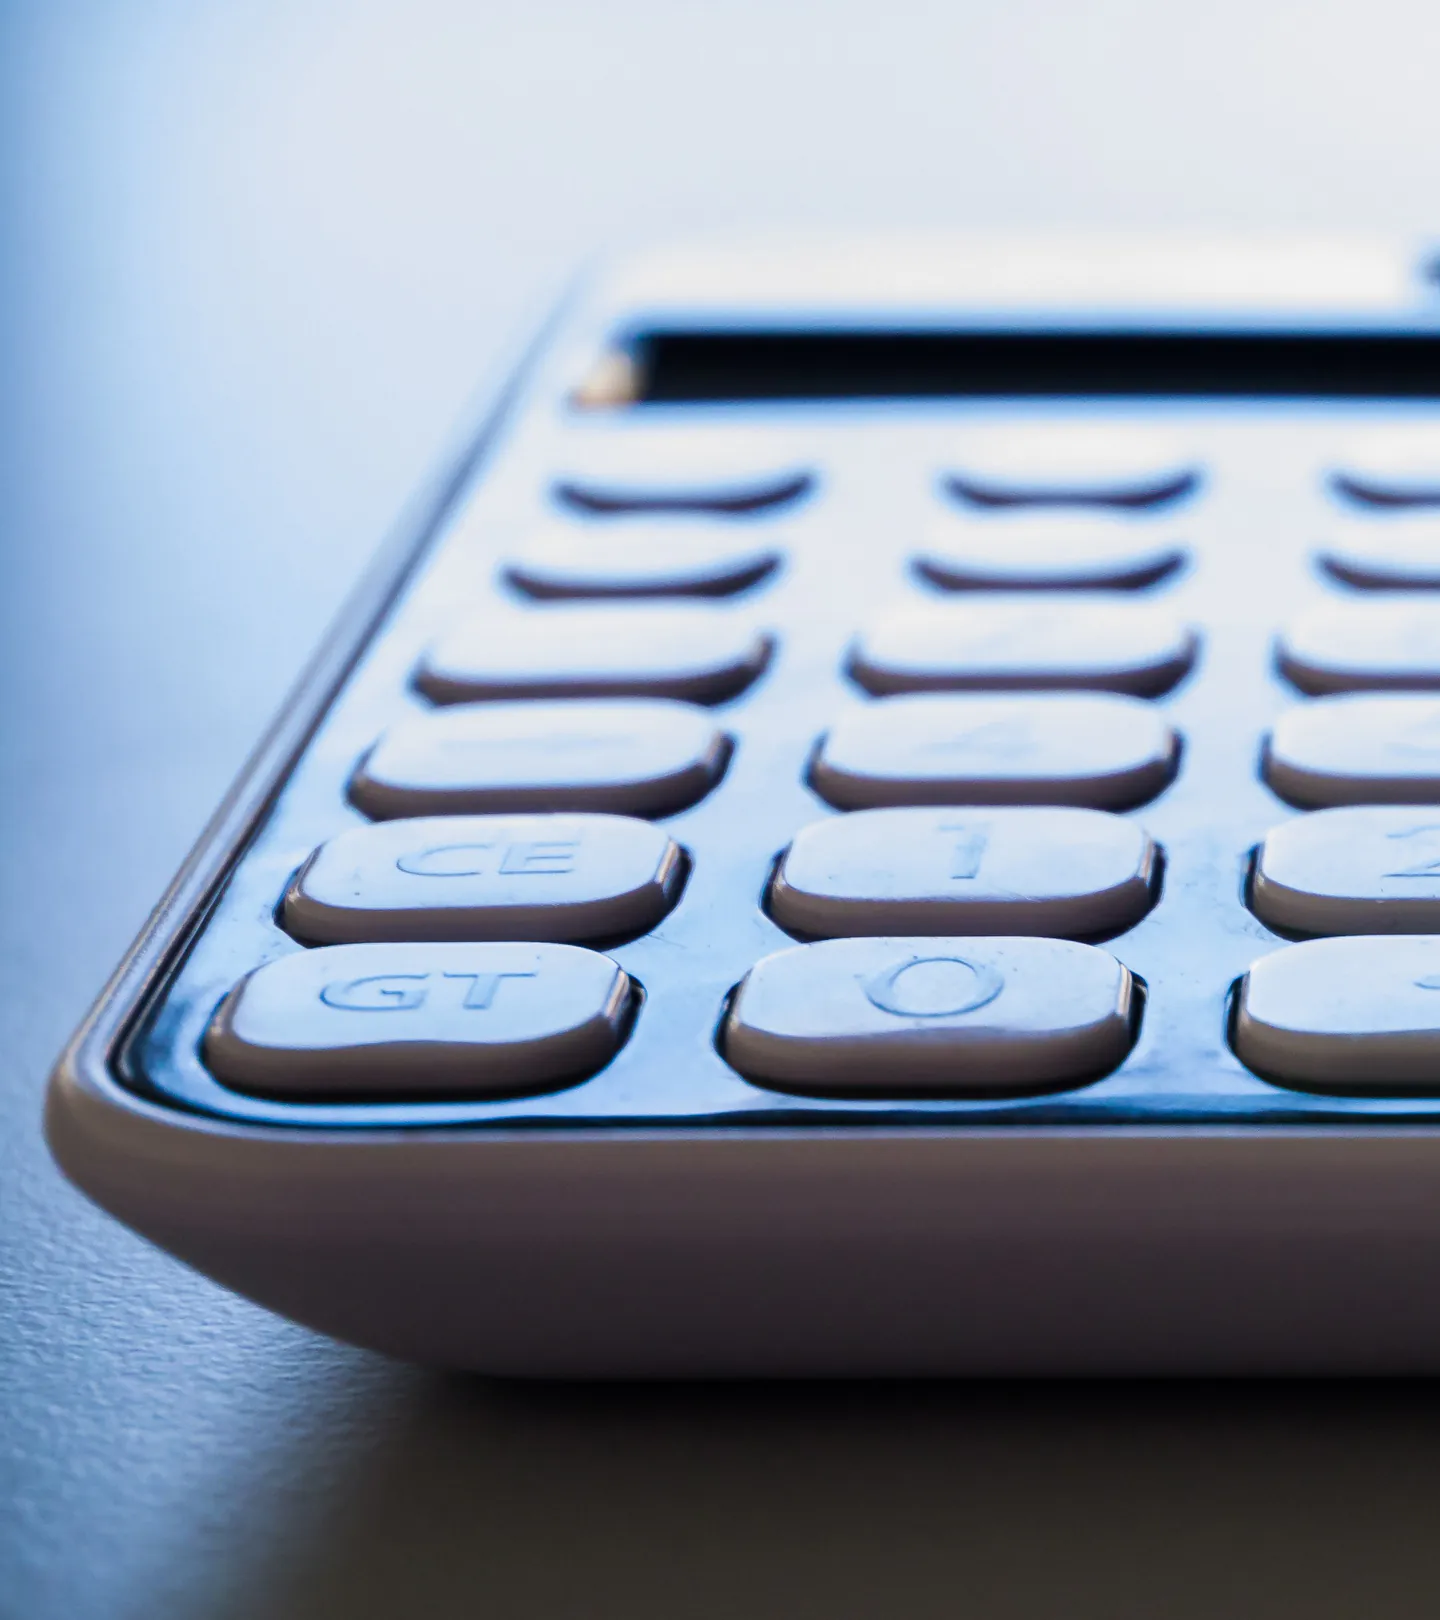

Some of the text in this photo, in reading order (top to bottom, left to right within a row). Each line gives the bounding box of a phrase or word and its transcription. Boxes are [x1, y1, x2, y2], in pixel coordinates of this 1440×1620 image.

[396, 841, 579, 876] CE
[937, 822, 991, 880] 1
[319, 970, 538, 1012] GT
[864, 955, 1005, 1018] 0
